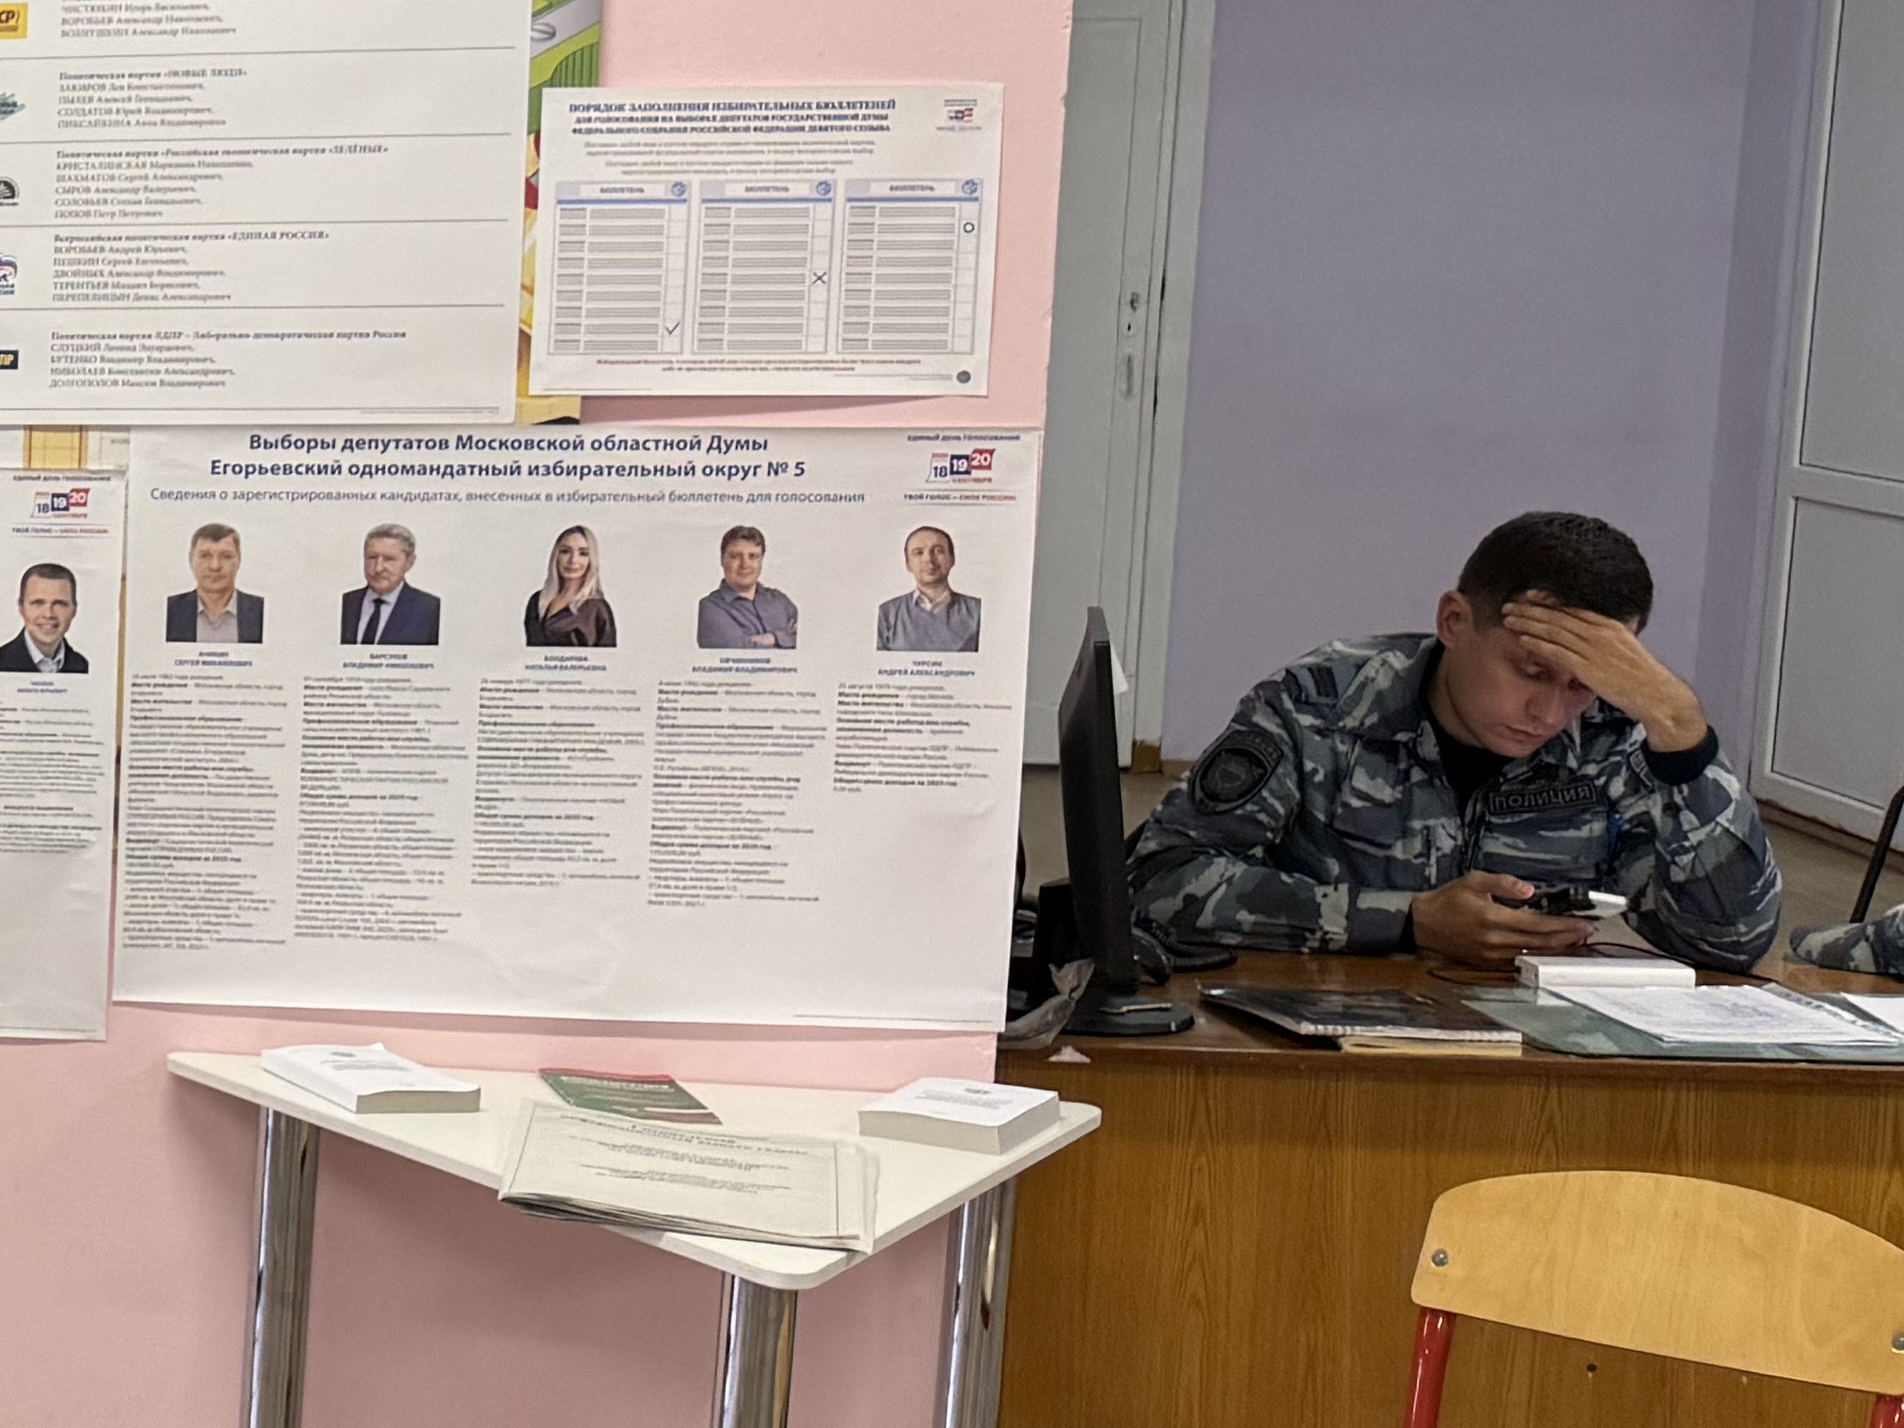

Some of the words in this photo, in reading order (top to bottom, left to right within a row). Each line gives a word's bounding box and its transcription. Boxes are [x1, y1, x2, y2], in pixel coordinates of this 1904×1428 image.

[249, 433, 336, 453] Выборы
[340, 438, 449, 453] депутатов
[455, 434, 584, 450] Московской
[590, 434, 701, 451] областной
[705, 434, 768, 454] Думы
[210, 459, 342, 478] Егорьевский
[347, 460, 521, 478] одномандатный
[527, 460, 695, 479] избирательный
[701, 464, 762, 481] округ
[766, 461, 788, 476] №
[793, 461, 805, 477] 5
[933, 465, 947, 479] 18
[952, 457, 968, 472] 19
[971, 451, 990, 466] 20
[1495, 784, 1590, 808] ПОЛИЦИЯ
